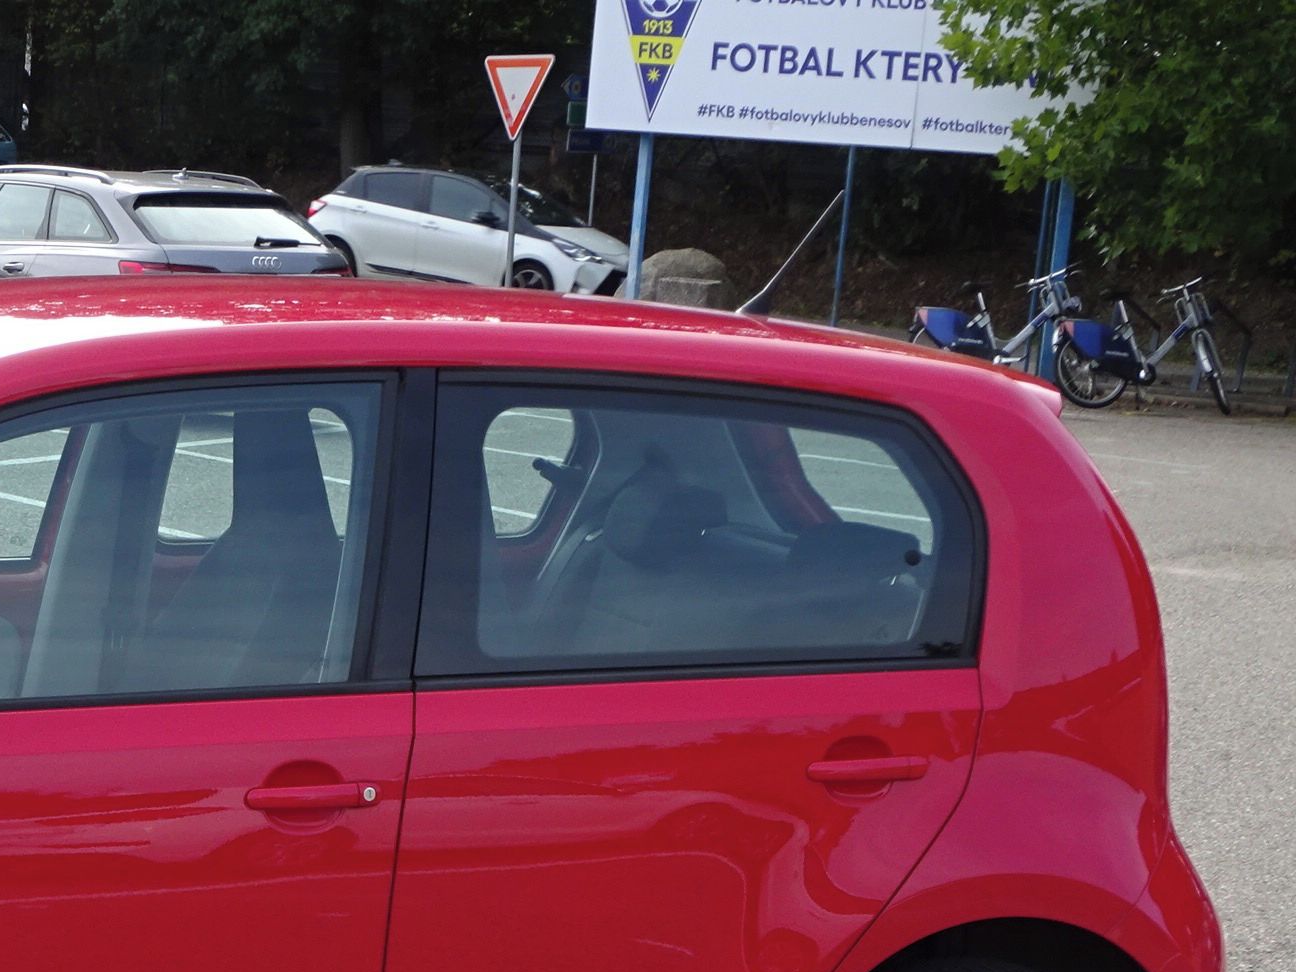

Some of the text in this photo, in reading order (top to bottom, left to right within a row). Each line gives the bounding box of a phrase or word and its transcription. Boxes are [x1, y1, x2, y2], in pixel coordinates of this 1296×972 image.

[643, 19, 674, 35] 1913
[638, 41, 674, 60] FKB
[710, 41, 844, 78] FOTBAL
[697, 103, 1011, 136] #FKB #fotbalovyklubbenesov #fotbalkter
